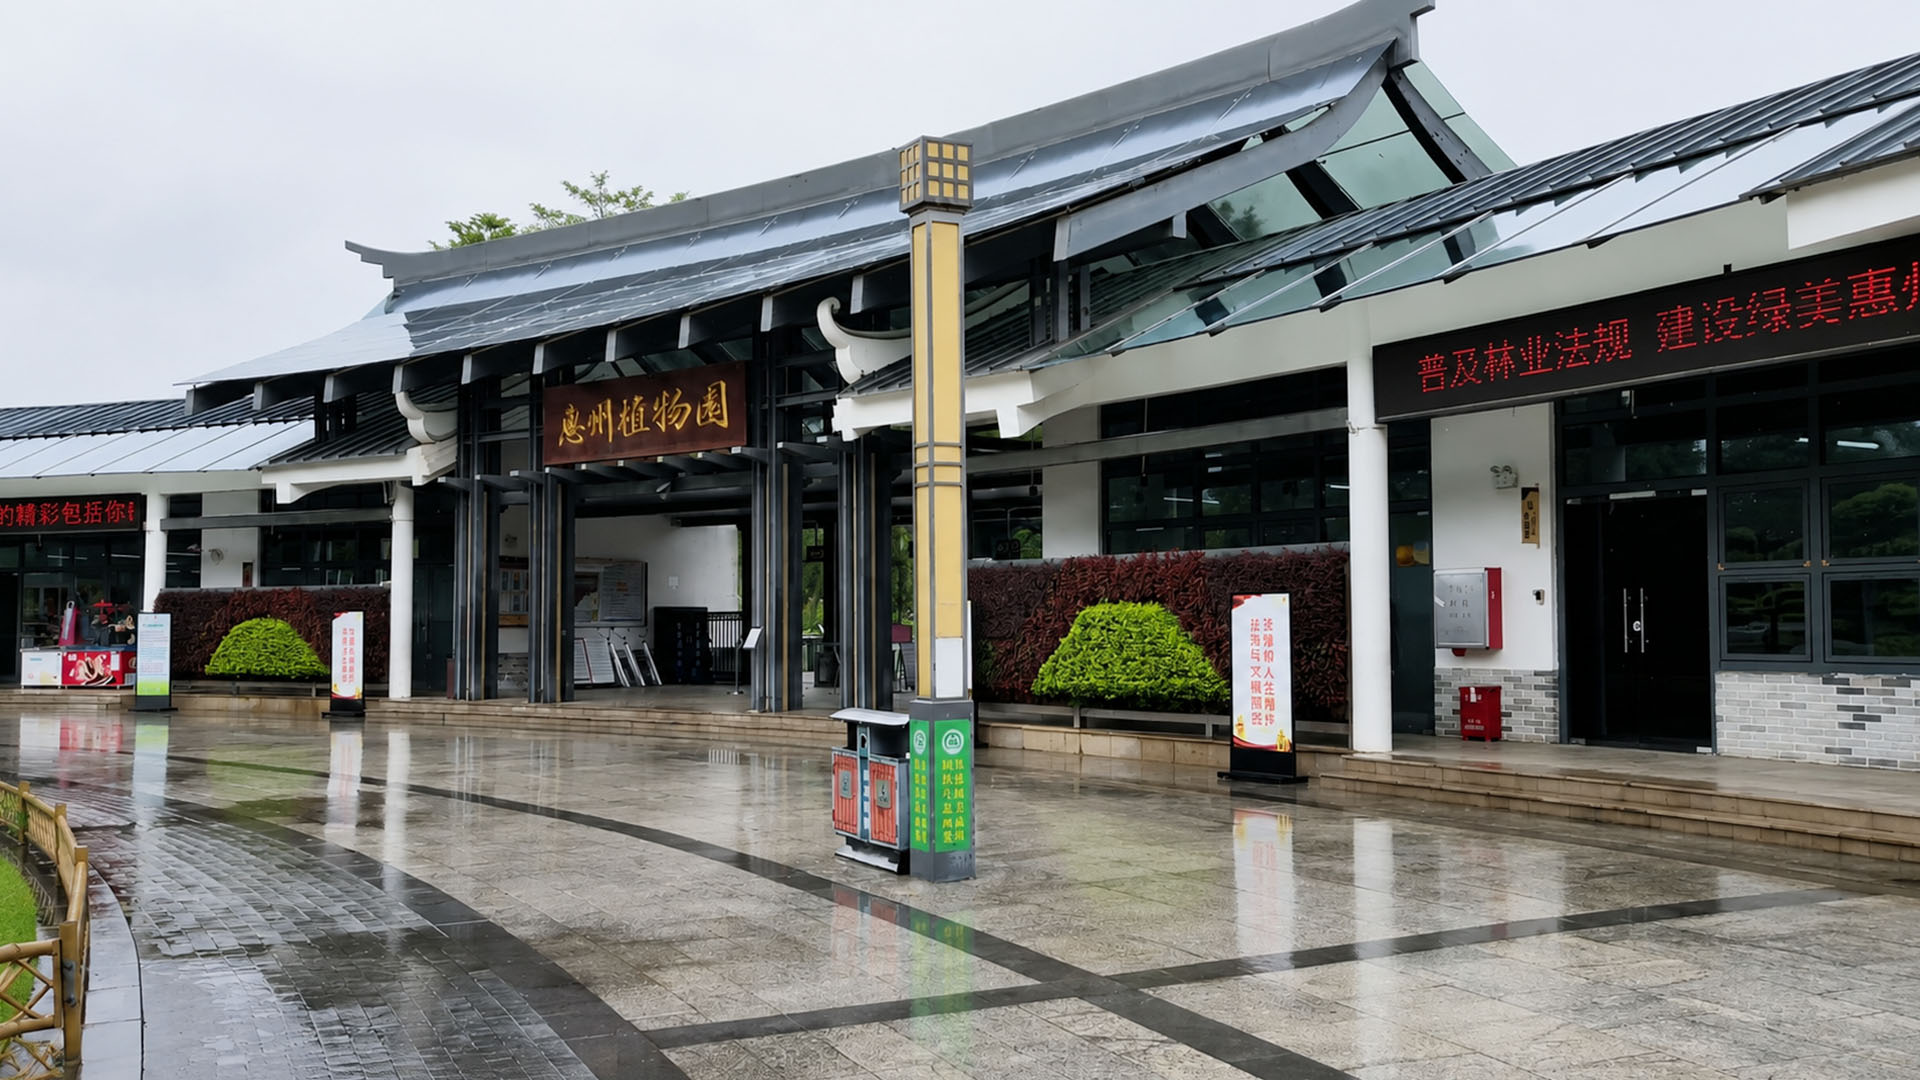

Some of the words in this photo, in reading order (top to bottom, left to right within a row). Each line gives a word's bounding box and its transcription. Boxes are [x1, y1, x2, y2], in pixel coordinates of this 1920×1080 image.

[1417, 318, 1633, 393] 普及林业法规
[558, 380, 729, 447] 惠州植物园
